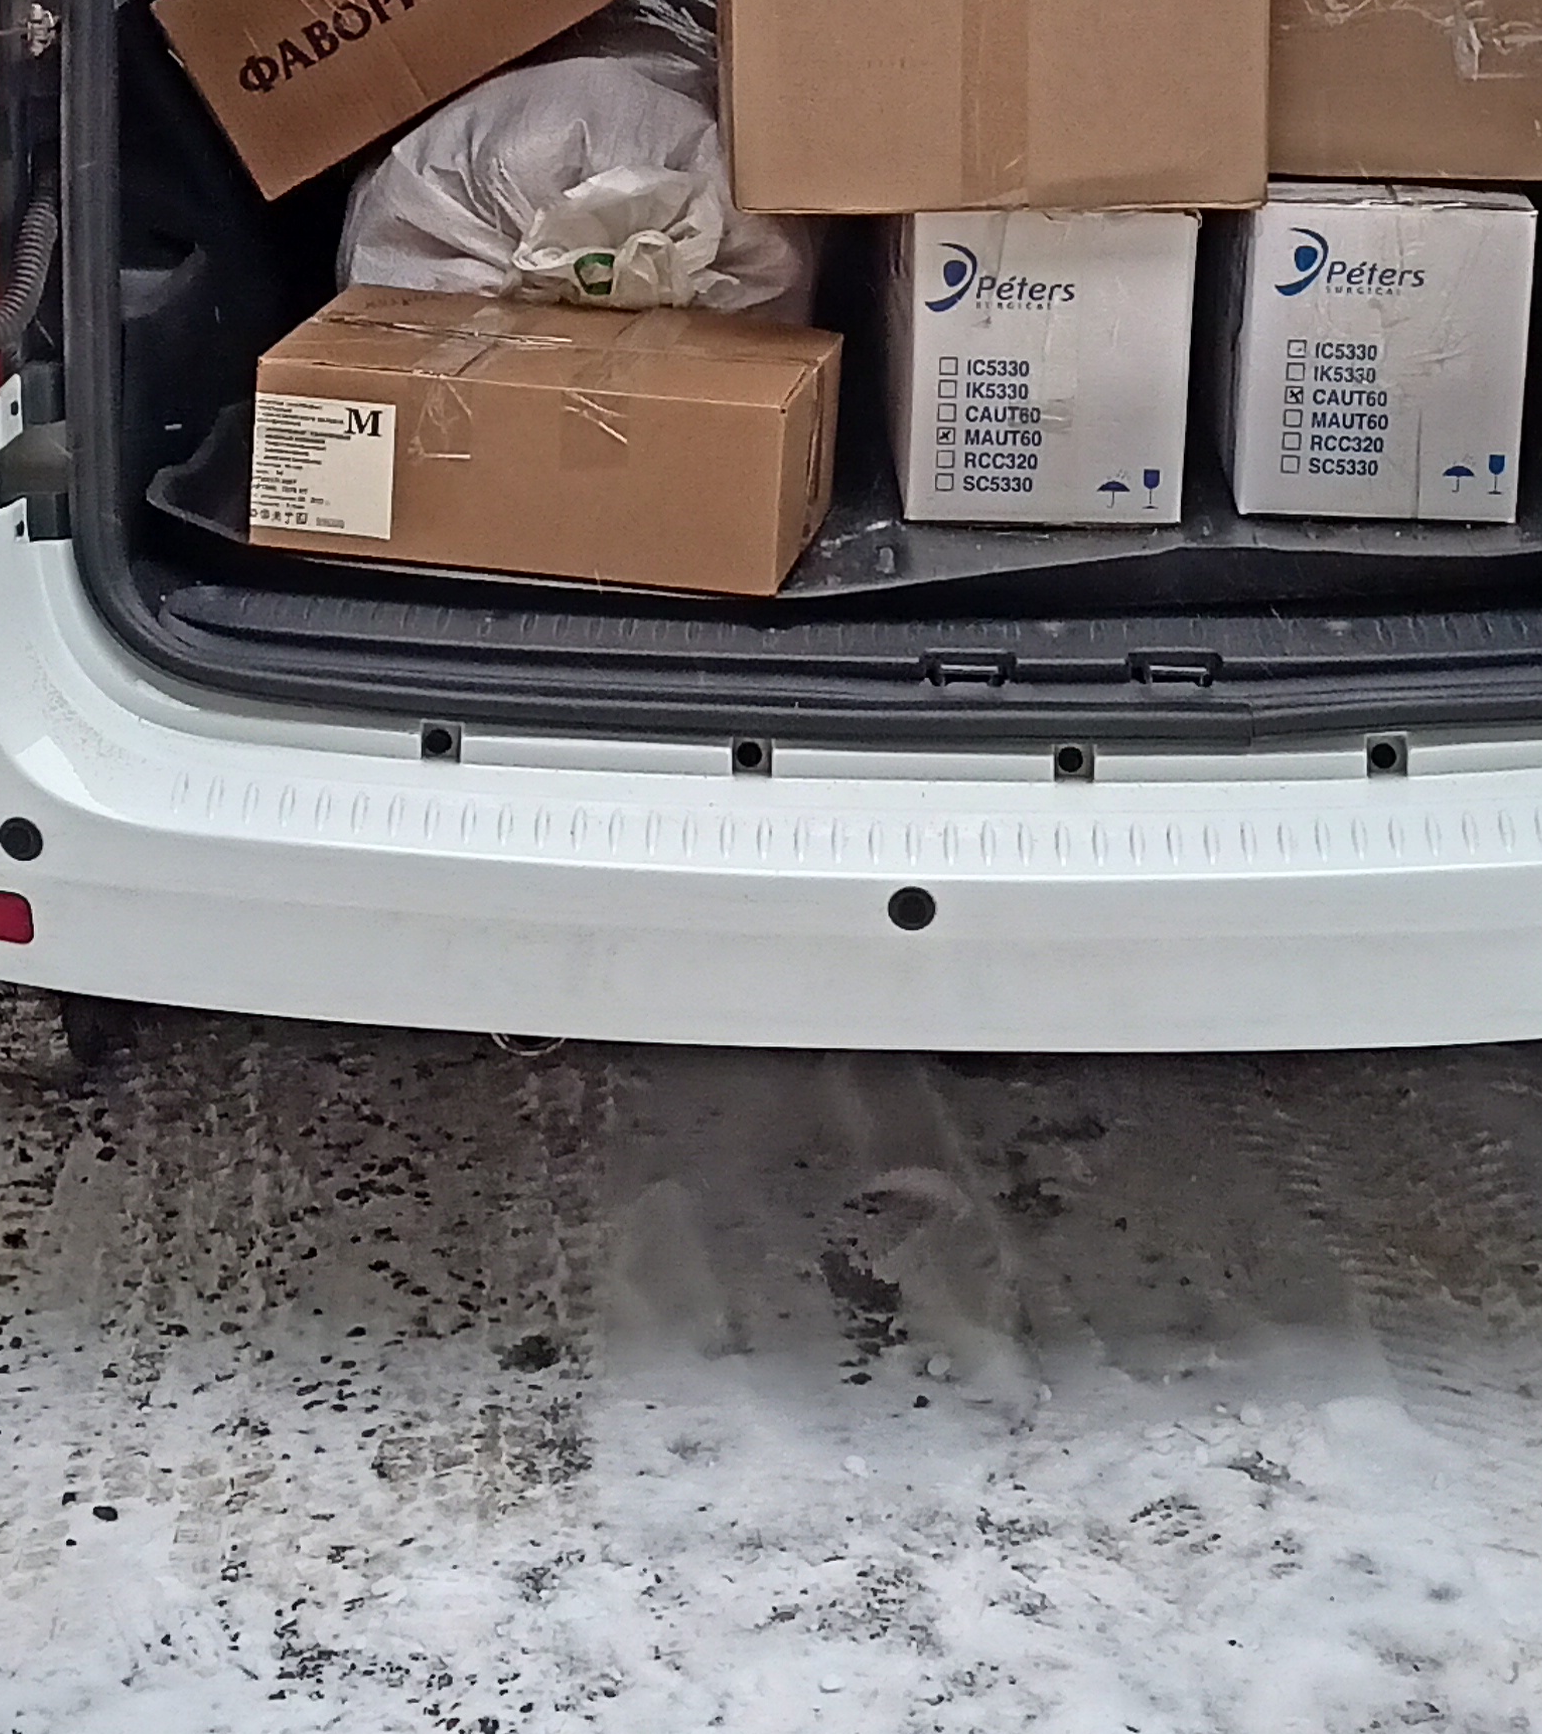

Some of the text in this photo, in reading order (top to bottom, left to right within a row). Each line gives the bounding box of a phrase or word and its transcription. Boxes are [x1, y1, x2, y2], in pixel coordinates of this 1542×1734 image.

[1327, 261, 1426, 288] Péters
[976, 276, 1075, 302] Péters
[1315, 342, 1378, 361] IC5330
[966, 359, 1030, 377] IC5330
[1314, 365, 1376, 384] IK5330
[966, 382, 1029, 400] IK5330
[1312, 389, 1388, 407] CAUT60
[344, 407, 383, 437] M
[965, 405, 1041, 424] CAUT60
[1311, 412, 1389, 430] MAUT60
[964, 429, 1042, 446] MAUT60
[1310, 434, 1384, 453] RCC320
[964, 452, 1038, 469] RCC320
[1308, 457, 1379, 476] SC5330
[963, 475, 1033, 492] SC5330
